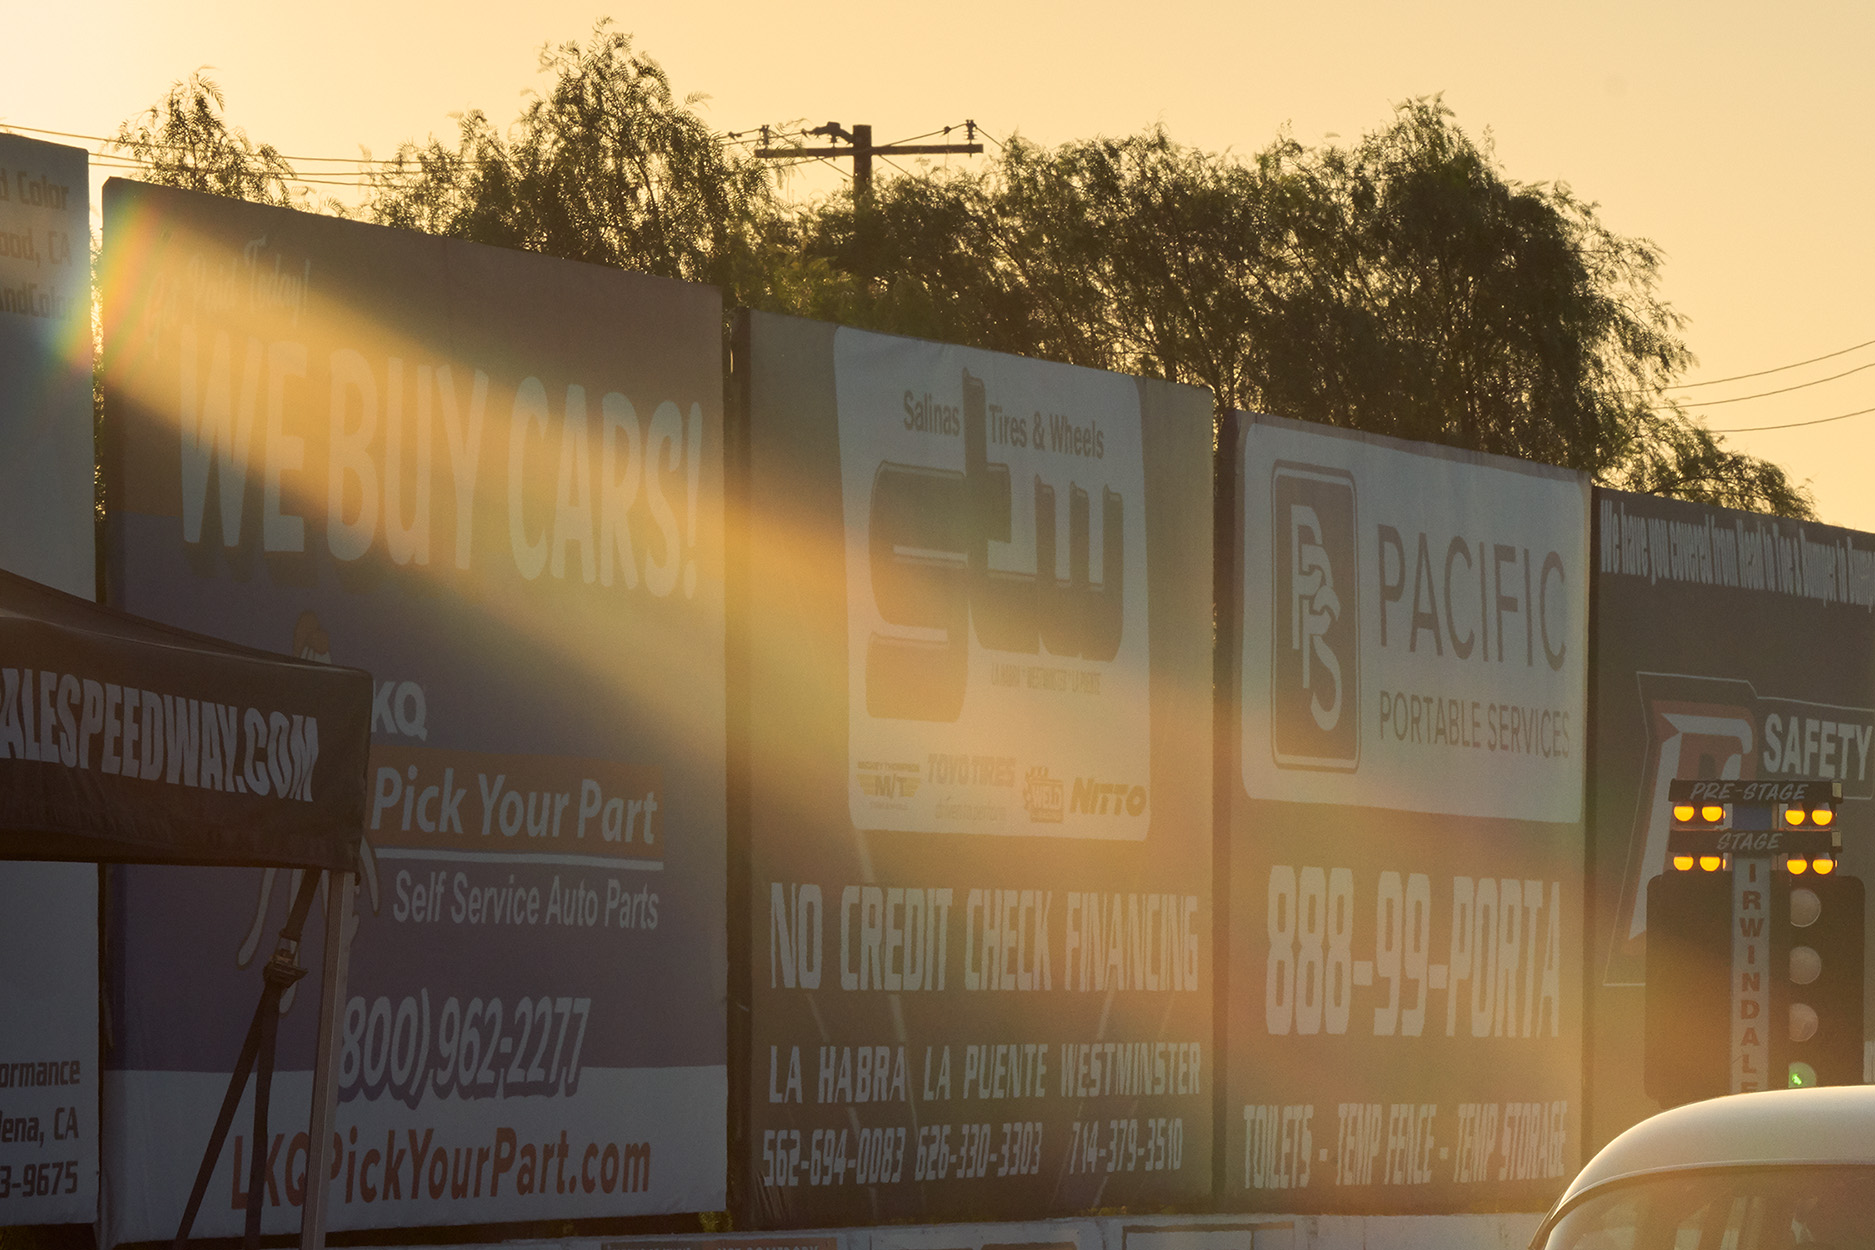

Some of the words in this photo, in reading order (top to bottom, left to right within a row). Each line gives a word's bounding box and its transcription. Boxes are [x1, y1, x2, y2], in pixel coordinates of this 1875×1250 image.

[903, 391, 961, 438] Salinas
[989, 404, 1028, 450] Tires
[1033, 411, 1046, 450] &
[1049, 413, 1105, 461] Wheels
[180, 325, 307, 553] WE
[325, 349, 490, 570] BUY
[507, 376, 700, 599] CARS!
[1600, 499, 1619, 574] We
[1620, 502, 1648, 577] have
[1377, 523, 1567, 672] PACIFIC
[0, 667, 319, 802] ALESPEEDWAY.COM
[371, 680, 427, 742] KQ
[1379, 689, 1481, 748] PORTABLE
[1487, 702, 1570, 758] SERVICES
[1763, 712, 1873, 781] SAFETY
[371, 764, 467, 834] Pick
[479, 774, 569, 837] Your
[577, 779, 658, 844] Part
[1689, 782, 1808, 801] PRE-STAGE
[1716, 832, 1783, 850] STAGE
[393, 870, 446, 922] Self
[451, 872, 540, 924] Service
[545, 875, 598, 927] Auto
[605, 879, 660, 930] Parts
[770, 883, 823, 990] NO
[840, 886, 953, 991] CREDIT
[964, 888, 1052, 992] CHECK
[1065, 891, 1199, 992] FINANCING
[1265, 865, 1560, 1037] 888-99-PORTA
[338, 986, 431, 1096] 800)
[769, 1045, 802, 1103] LA
[817, 1045, 906, 1103] HABRA
[923, 1044, 951, 1101] LA
[963, 1043, 1049, 1099] PUENTE
[1060, 1041, 1201, 1098] WESTMINSTER
[0, 1106, 45, 1148] ena,
[54, 1106, 79, 1140] CA
[763, 1127, 906, 1186] 562-694-0083
[914, 1121, 1043, 1180] 626-330-3303
[1069, 1118, 1184, 1175] 714-379-3510
[1244, 1104, 1313, 1189] TOILETS
[1336, 1103, 1382, 1185] TEMP
[1384, 1103, 1437, 1185] FENCE
[1453, 1103, 1499, 1183] TEMP
[0, 1160, 79, 1198] 3-9675
